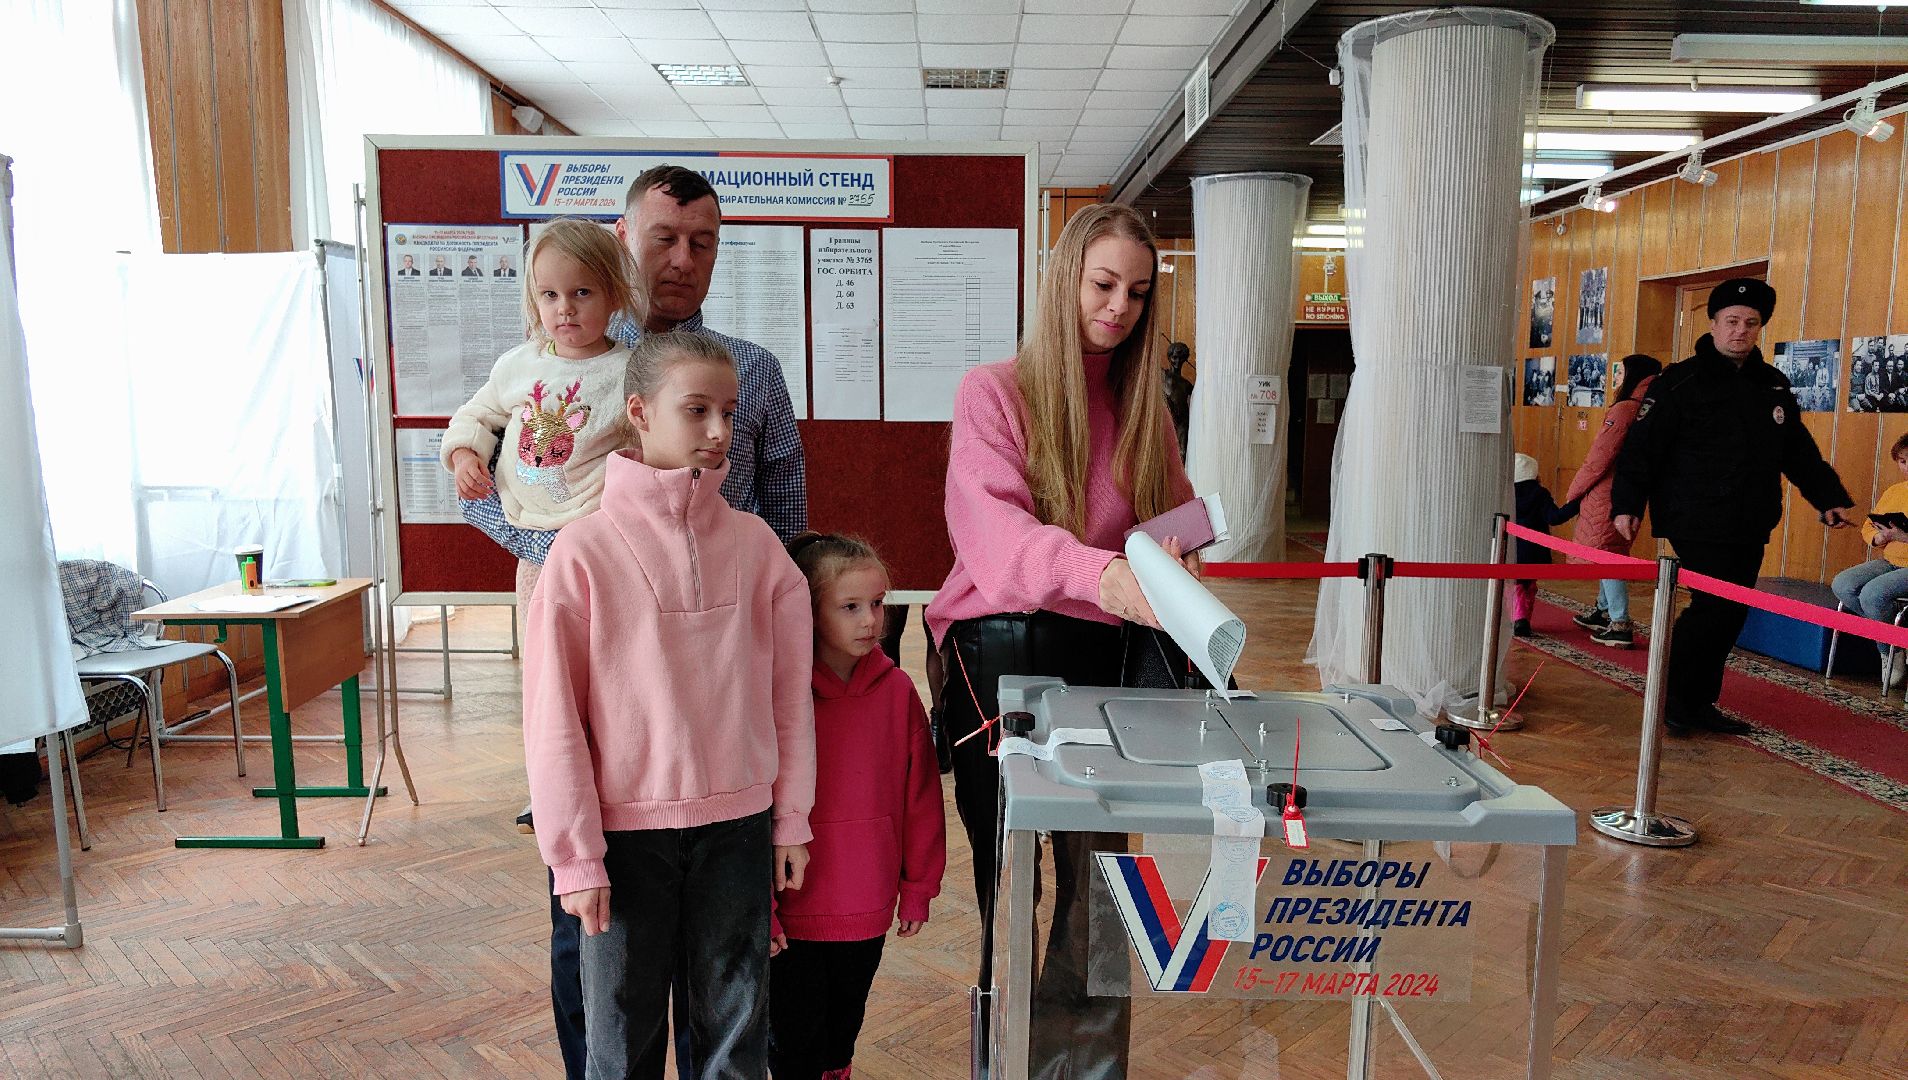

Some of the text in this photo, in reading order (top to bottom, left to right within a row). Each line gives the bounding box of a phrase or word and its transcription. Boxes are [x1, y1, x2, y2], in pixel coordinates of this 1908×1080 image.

[566, 163, 611, 173] ВЫБОРЫ
[561, 175, 625, 186] ПРЕЗИДЕНТА
[700, 169, 875, 190] МАЦИОННЫЙ СТЕНД
[557, 187, 597, 196] РОССИИ
[573, 198, 598, 207] МАРТА
[599, 199, 617, 207] 2024
[719, 195, 784, 205] БИРАТЕЛЬНАЯ
[786, 196, 836, 206] КОМИССИЯ
[837, 196, 847, 206] №
[829, 237, 861, 245] Границы
[817, 267, 873, 276] ГОС. ОРБИТА
[1314, 294, 1339, 302] ВЫХОД
[1259, 390, 1277, 401] 708
[1282, 859, 1432, 889] ВЫБОРЫ
[1264, 897, 1472, 930] ПРЕЗИДЕНТА
[1249, 933, 1382, 963] РОССИИ
[1301, 972, 1380, 997] МАРТА
[1383, 973, 1440, 997] 2024
